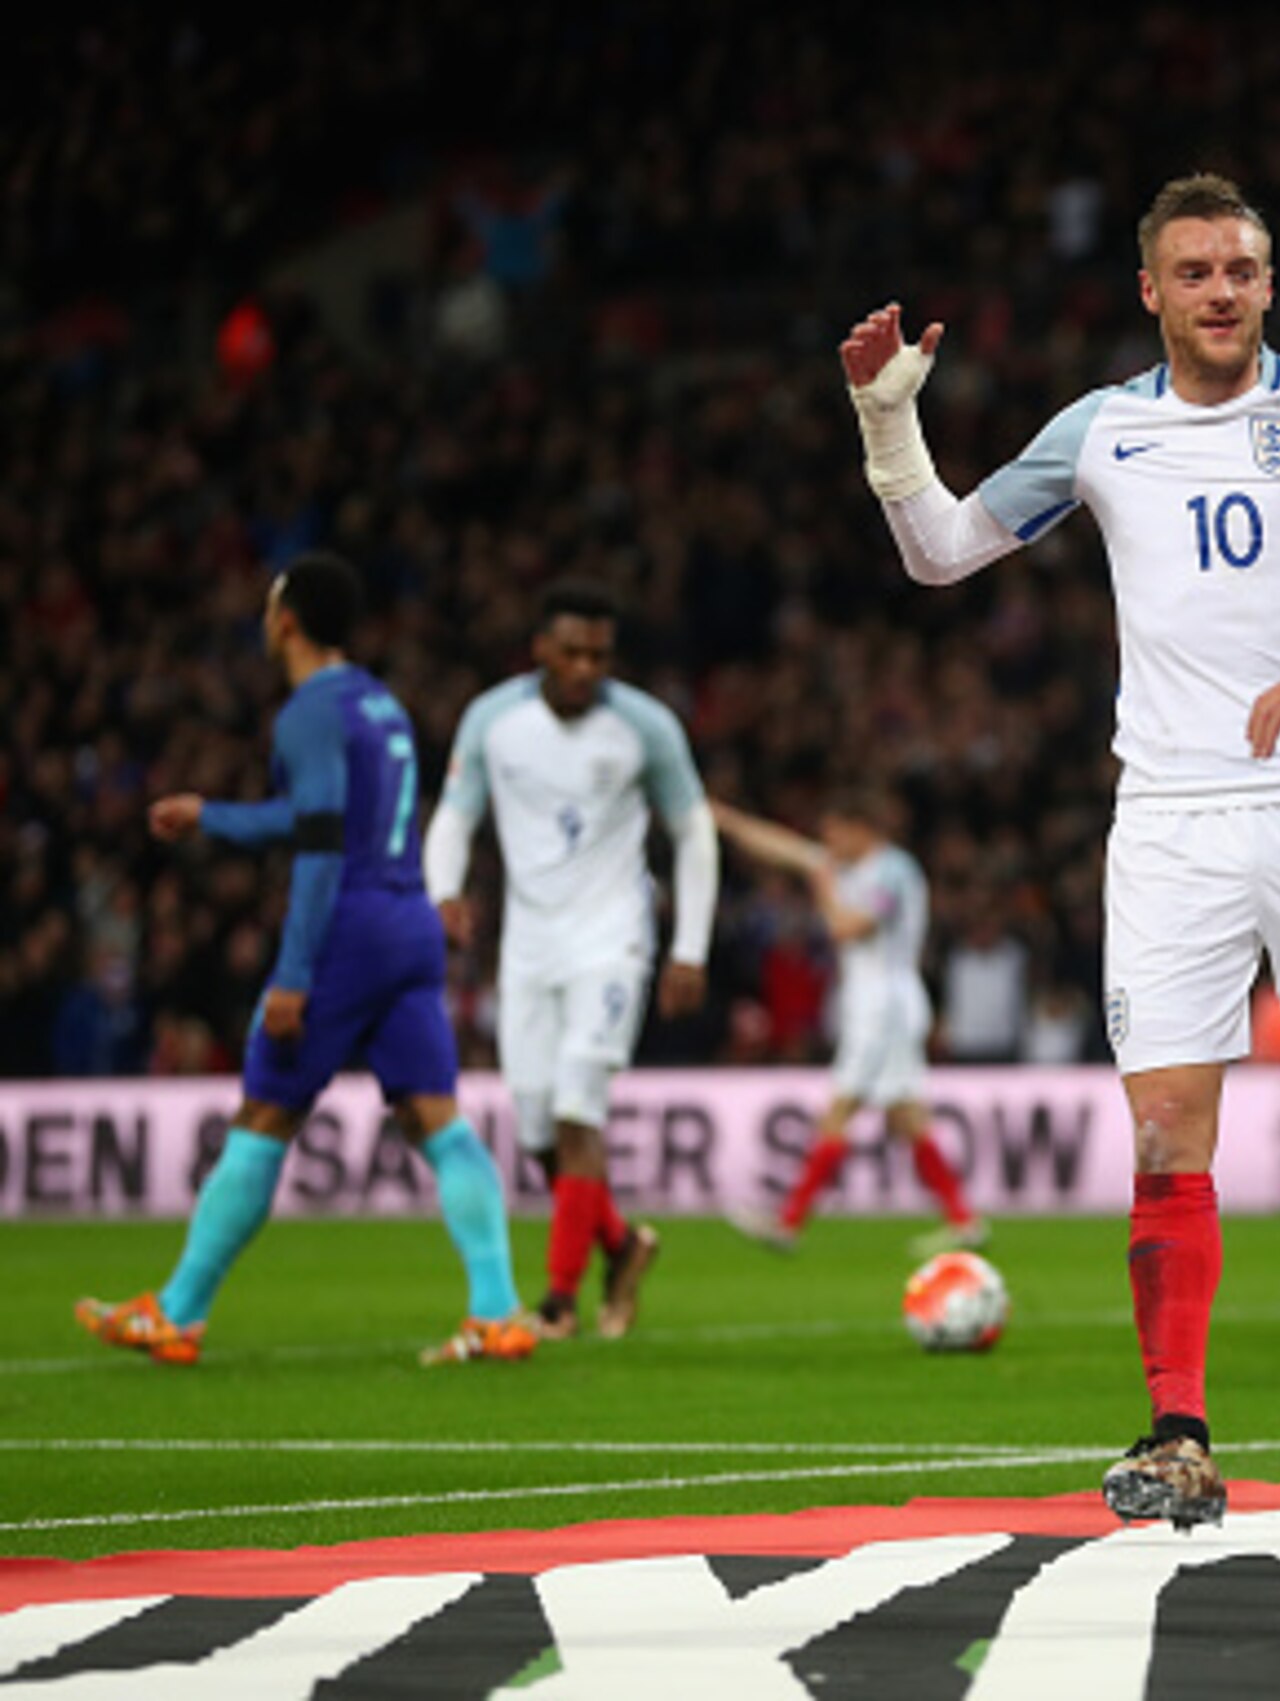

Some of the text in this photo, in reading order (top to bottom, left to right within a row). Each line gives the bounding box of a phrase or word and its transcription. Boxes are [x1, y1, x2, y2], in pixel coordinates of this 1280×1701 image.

[1186, 491, 1263, 572] 10
[386, 732, 418, 858] 7
[557, 804, 585, 856] 9
[292, 1104, 716, 1200] SAER
[758, 1102, 1090, 1200] SHOW
